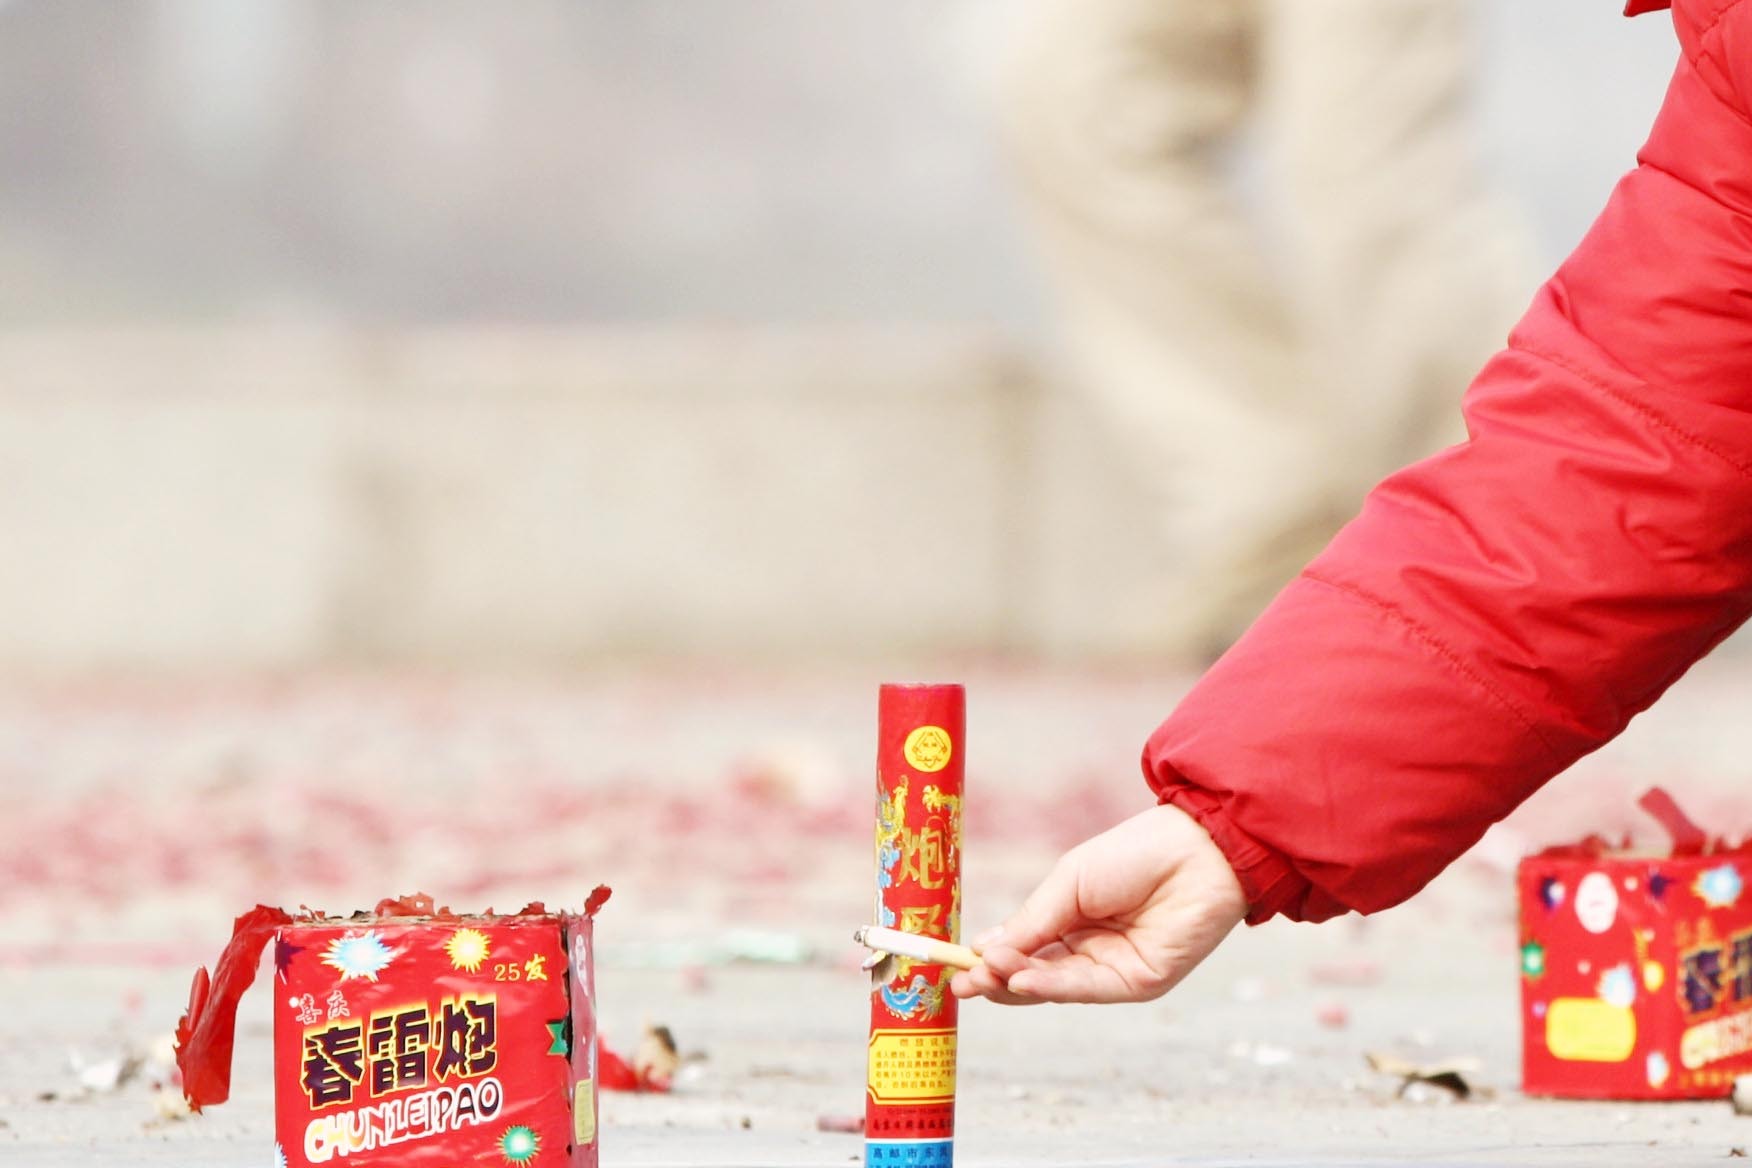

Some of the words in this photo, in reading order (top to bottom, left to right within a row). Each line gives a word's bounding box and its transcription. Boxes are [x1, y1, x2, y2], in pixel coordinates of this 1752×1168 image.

[301, 996, 498, 1110] 春雷炮
[304, 1077, 503, 1163] CHUNLEIPAO
